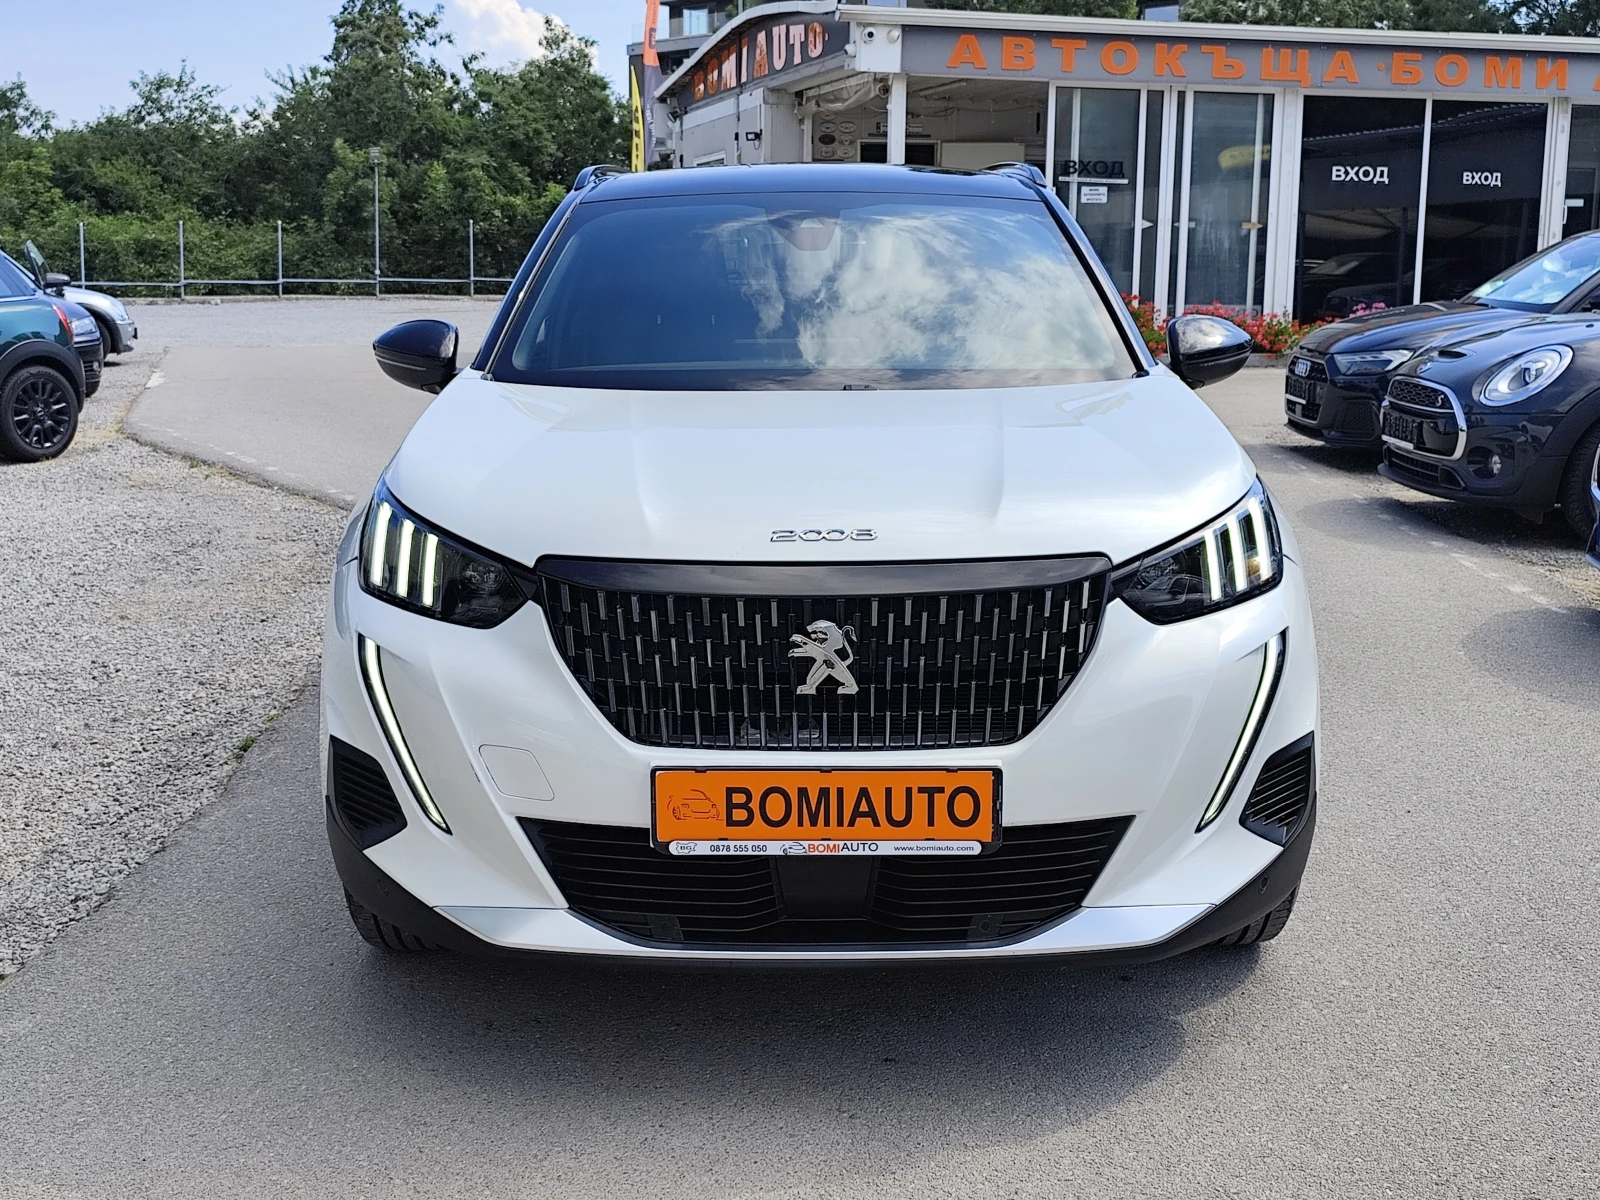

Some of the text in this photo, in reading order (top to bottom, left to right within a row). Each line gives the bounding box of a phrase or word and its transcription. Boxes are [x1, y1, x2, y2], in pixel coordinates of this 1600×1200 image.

[946, 34, 1569, 91] АВТОКЪЩА БОМИ
[1063, 160, 1125, 178] ВХОД
[1331, 165, 1390, 185] ВХОД
[1462, 171, 1502, 187] ВХОД
[769, 528, 879, 542] 2008
[725, 786, 981, 828] BOMIAUTO
[709, 844, 731, 853] 0878
[733, 844, 749, 853] 555
[751, 844, 768, 853] 050
